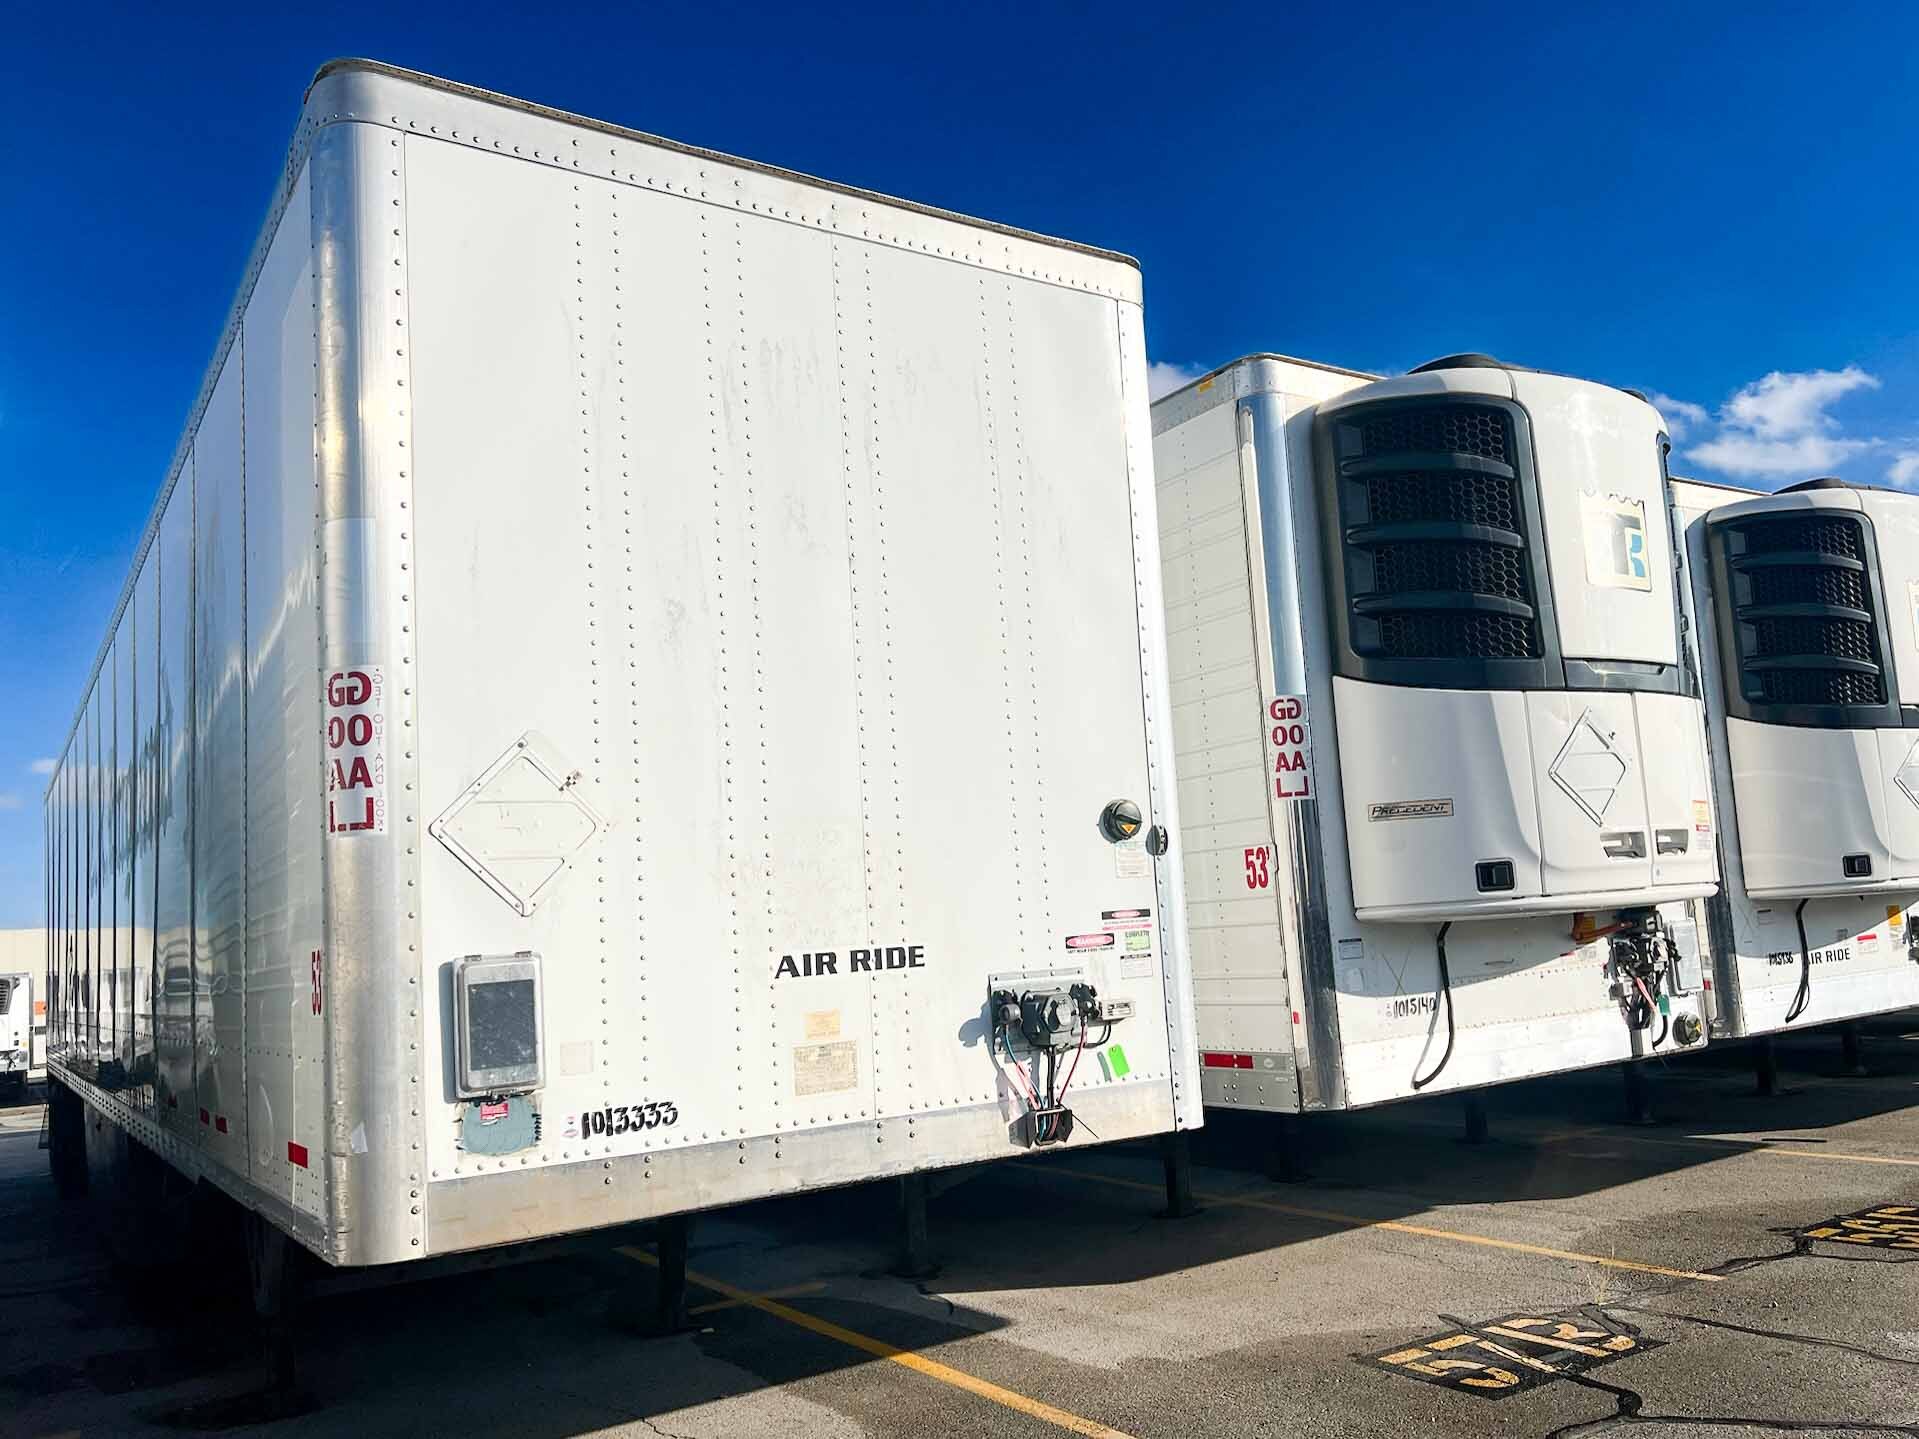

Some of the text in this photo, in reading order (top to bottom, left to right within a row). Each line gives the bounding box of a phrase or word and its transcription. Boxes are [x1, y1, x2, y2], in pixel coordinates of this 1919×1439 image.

[1244, 846, 1270, 889] 53'
[774, 945, 926, 979] AIR RIDE
[1825, 947, 1851, 963] RIDE
[1393, 996, 1437, 1018] 1015140
[581, 1101, 679, 1140] 1013333
